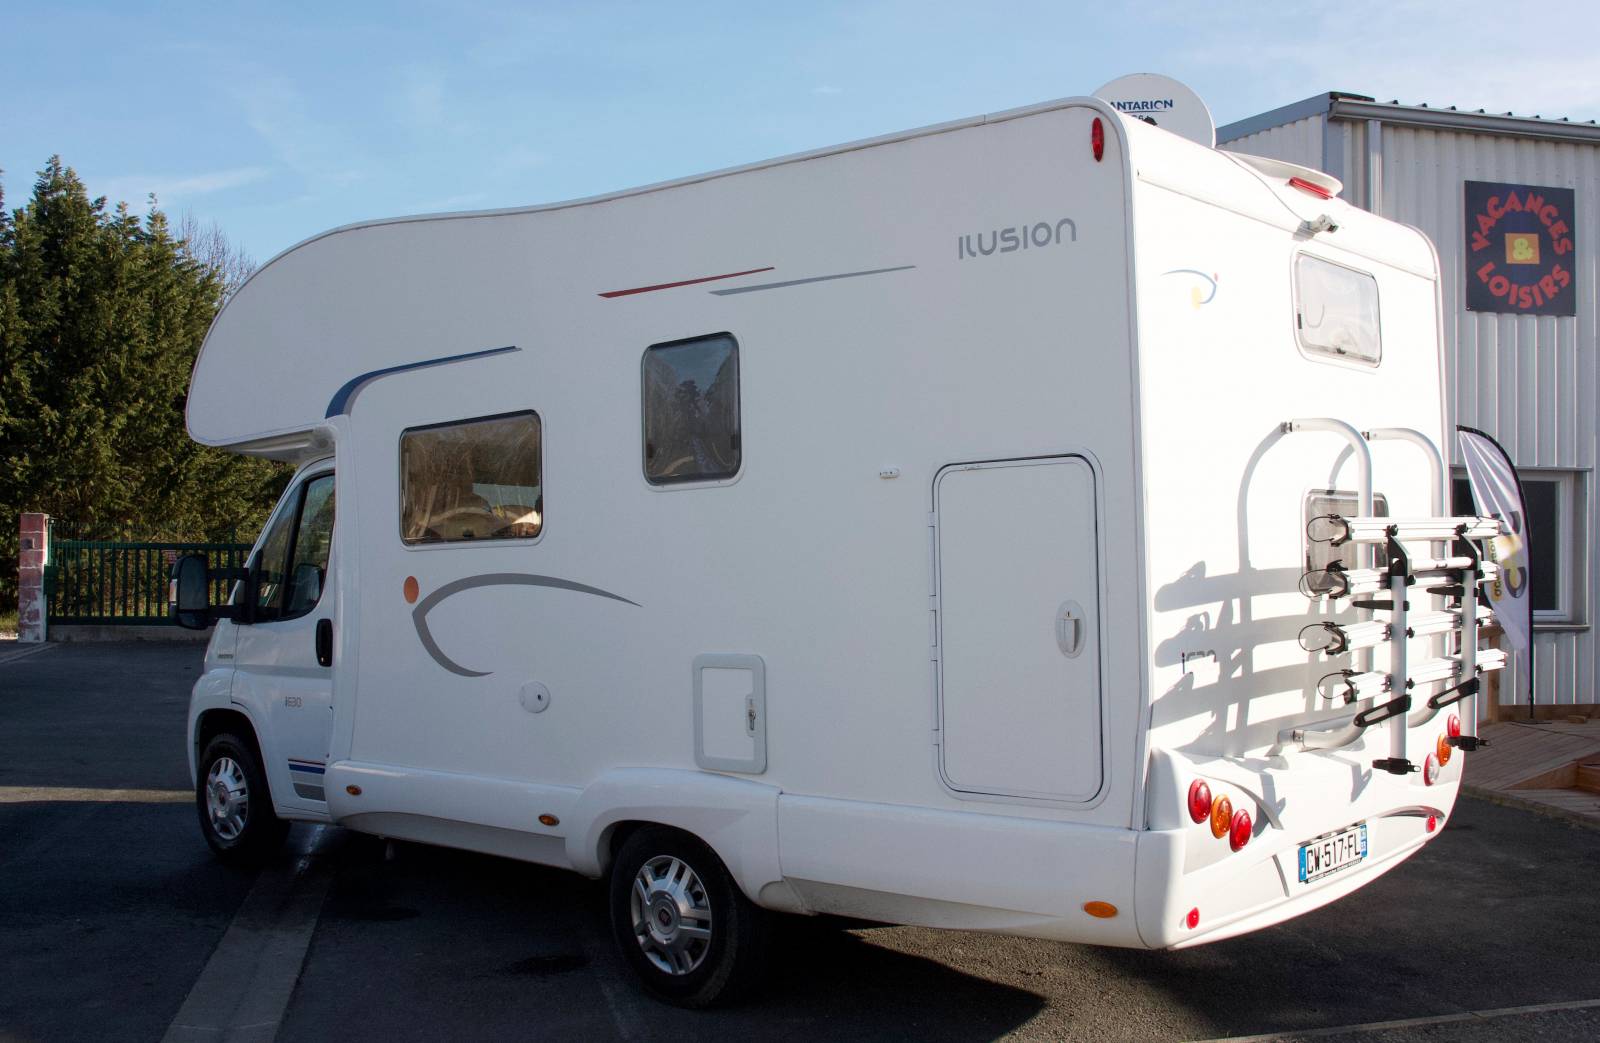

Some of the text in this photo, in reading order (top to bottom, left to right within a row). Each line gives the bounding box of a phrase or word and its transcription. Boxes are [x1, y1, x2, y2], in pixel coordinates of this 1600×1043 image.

[958, 218, 1077, 260] ILUSION
[1472, 191, 1573, 256] VACANCES
[1512, 237, 1534, 261] &
[1476, 261, 1570, 309] LOISIRS
